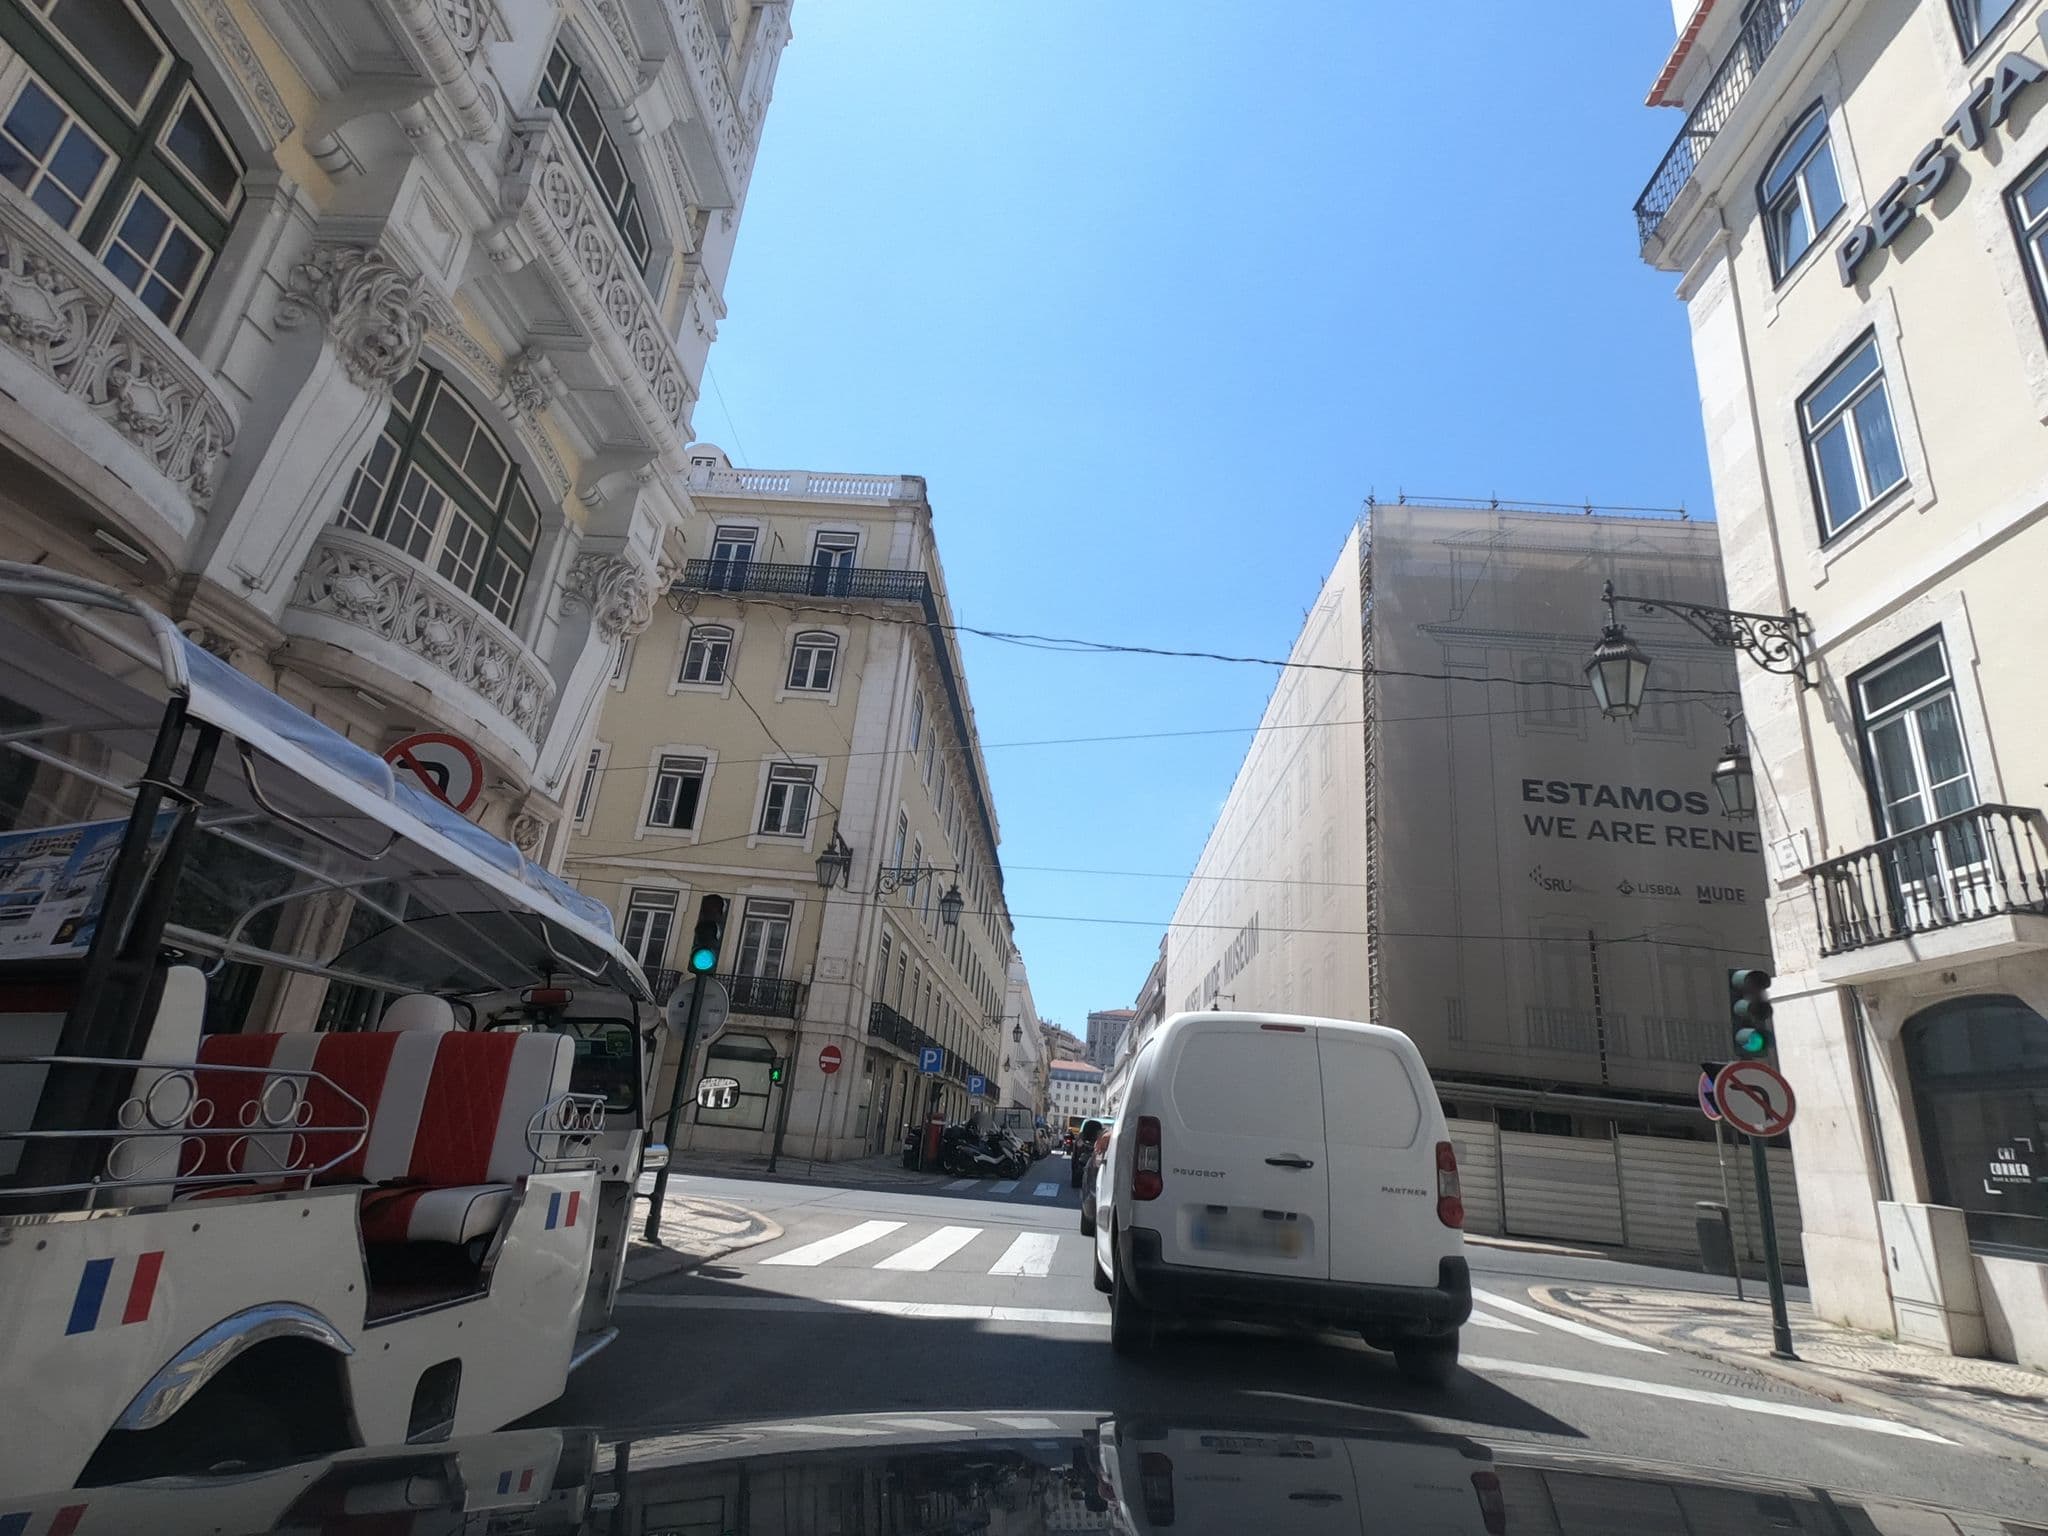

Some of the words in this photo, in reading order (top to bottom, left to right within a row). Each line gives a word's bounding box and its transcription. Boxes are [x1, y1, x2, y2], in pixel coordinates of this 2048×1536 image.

[1836, 9, 2048, 288] PESTA
[1522, 779, 1709, 815] ESTAMOS
[1524, 814, 1577, 839] WE
[1587, 820, 1656, 845] ARE
[1665, 826, 1763, 853] RENE
[1543, 878, 1572, 892] SRU
[1639, 883, 1681, 896] LISBOA
[1697, 885, 1745, 902] MUDE
[1224, 910, 1259, 986] MUSEUM
[923, 1050, 937, 1070] P
[971, 1078, 981, 1092] P
[1172, 1167, 1227, 1179] PEUGEOT
[1381, 1186, 1428, 1197] PARTNER
